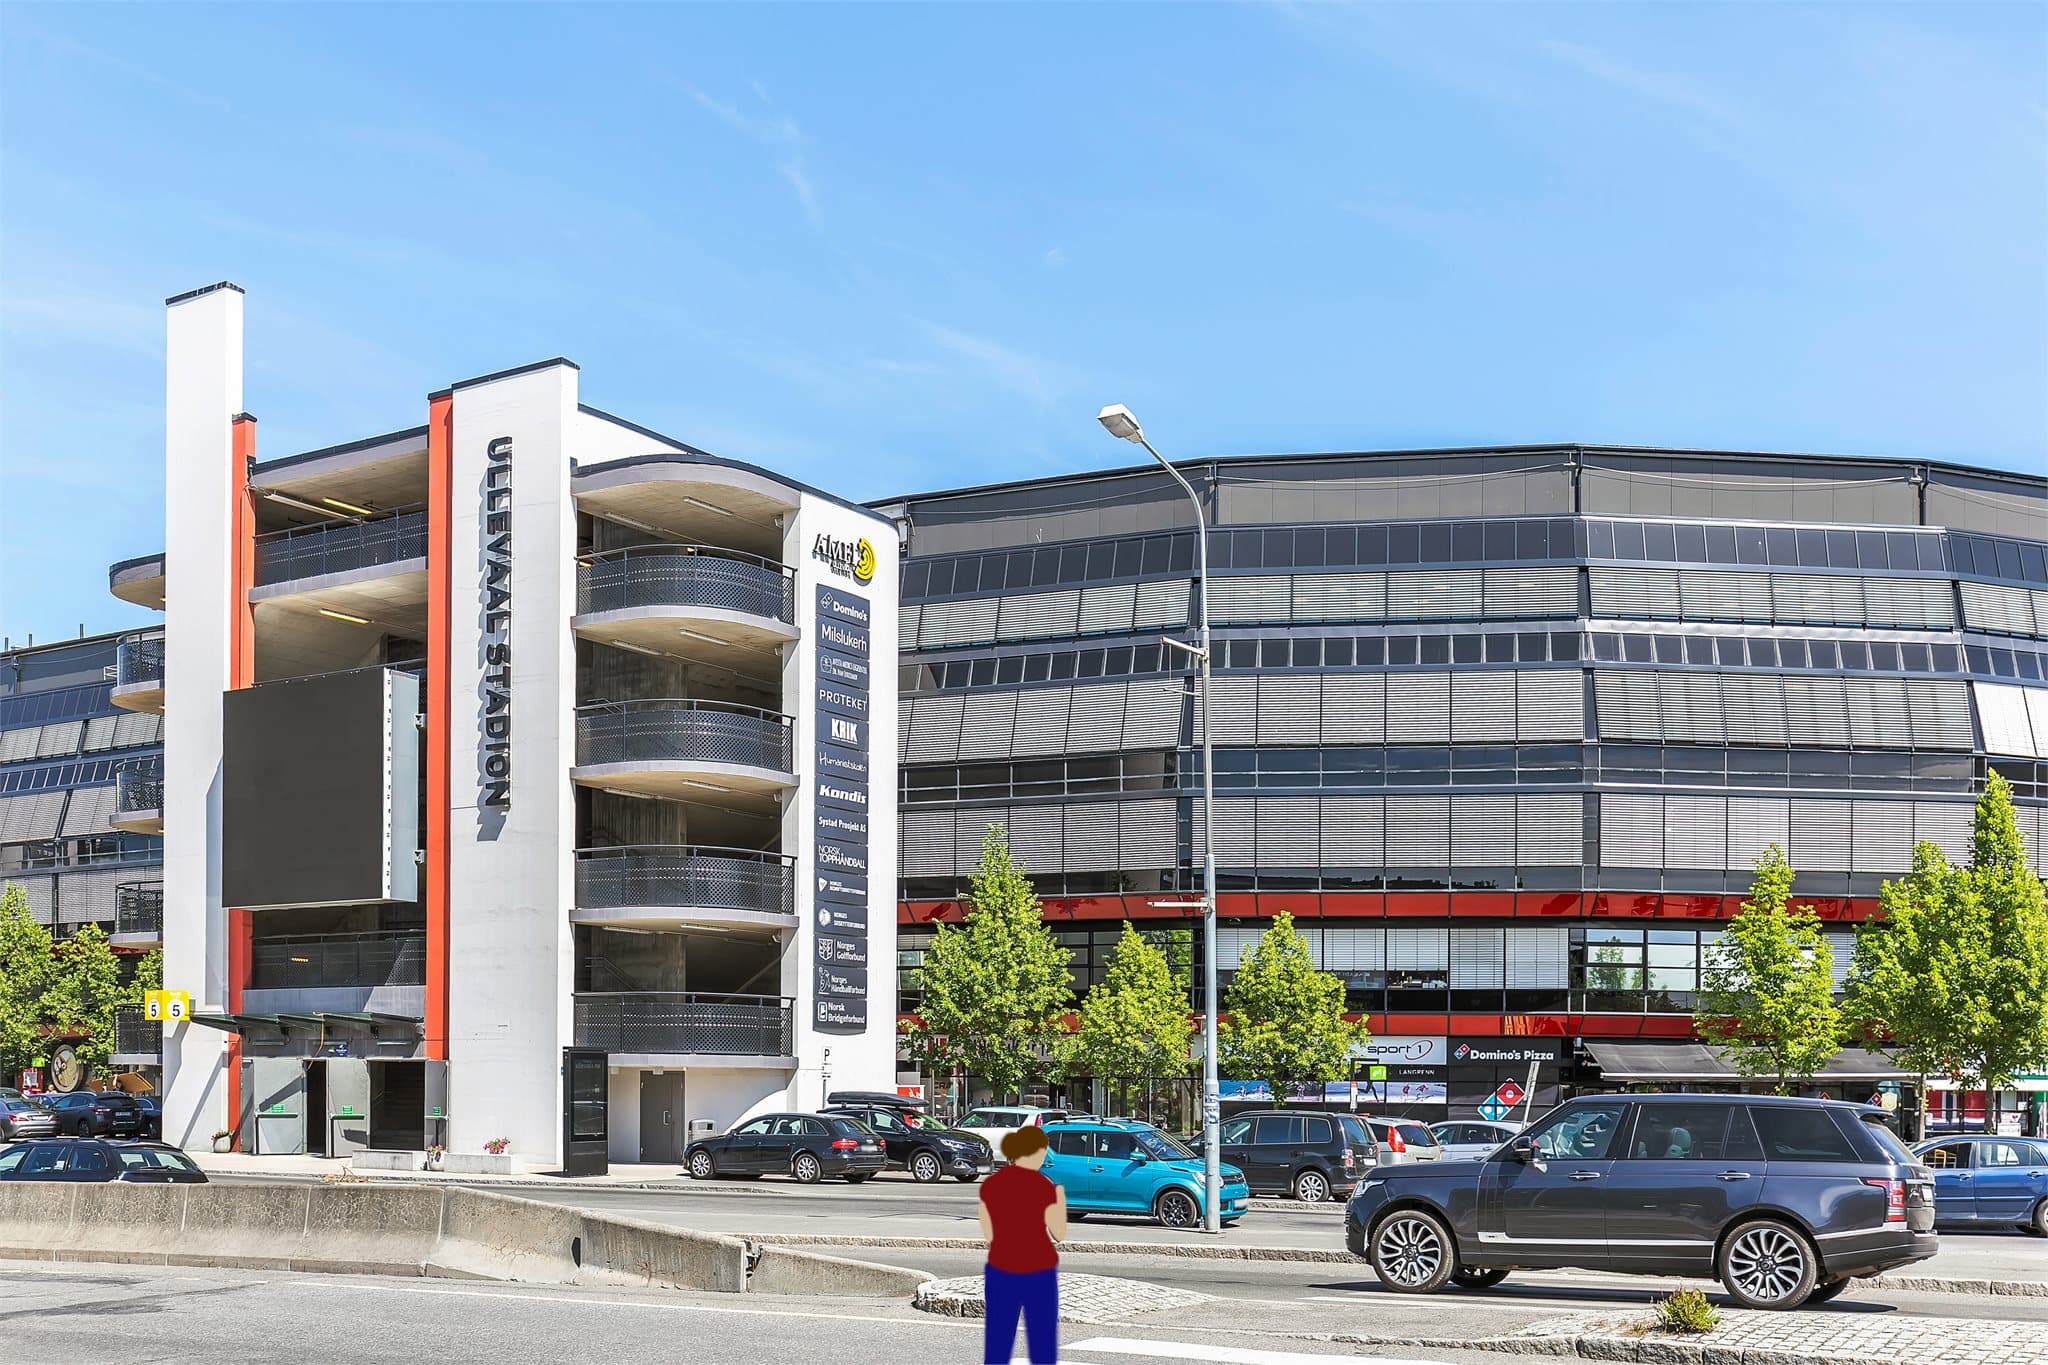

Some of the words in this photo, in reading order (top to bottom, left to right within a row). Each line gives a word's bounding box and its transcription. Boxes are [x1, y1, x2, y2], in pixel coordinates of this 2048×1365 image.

[487, 436, 512, 634] ULLEVAAL
[833, 601, 868, 622] Domino's
[819, 689, 867, 711] PROTEKET
[486, 643, 511, 807] STADION
[831, 718, 858, 742] KRIK
[819, 784, 867, 804] Kondis
[818, 816, 838, 828] Systad
[818, 844, 841, 855] NORSK
[837, 940, 856, 952] Norges
[151, 1004, 157, 1017] 5
[172, 1004, 180, 1017] 5
[828, 1001, 845, 1012] Norsk
[824, 1048, 831, 1062] P
[1367, 1044, 1413, 1056] sport
[1470, 1049, 1521, 1060] Domino's
[1523, 1049, 1554, 1060] Pizza
